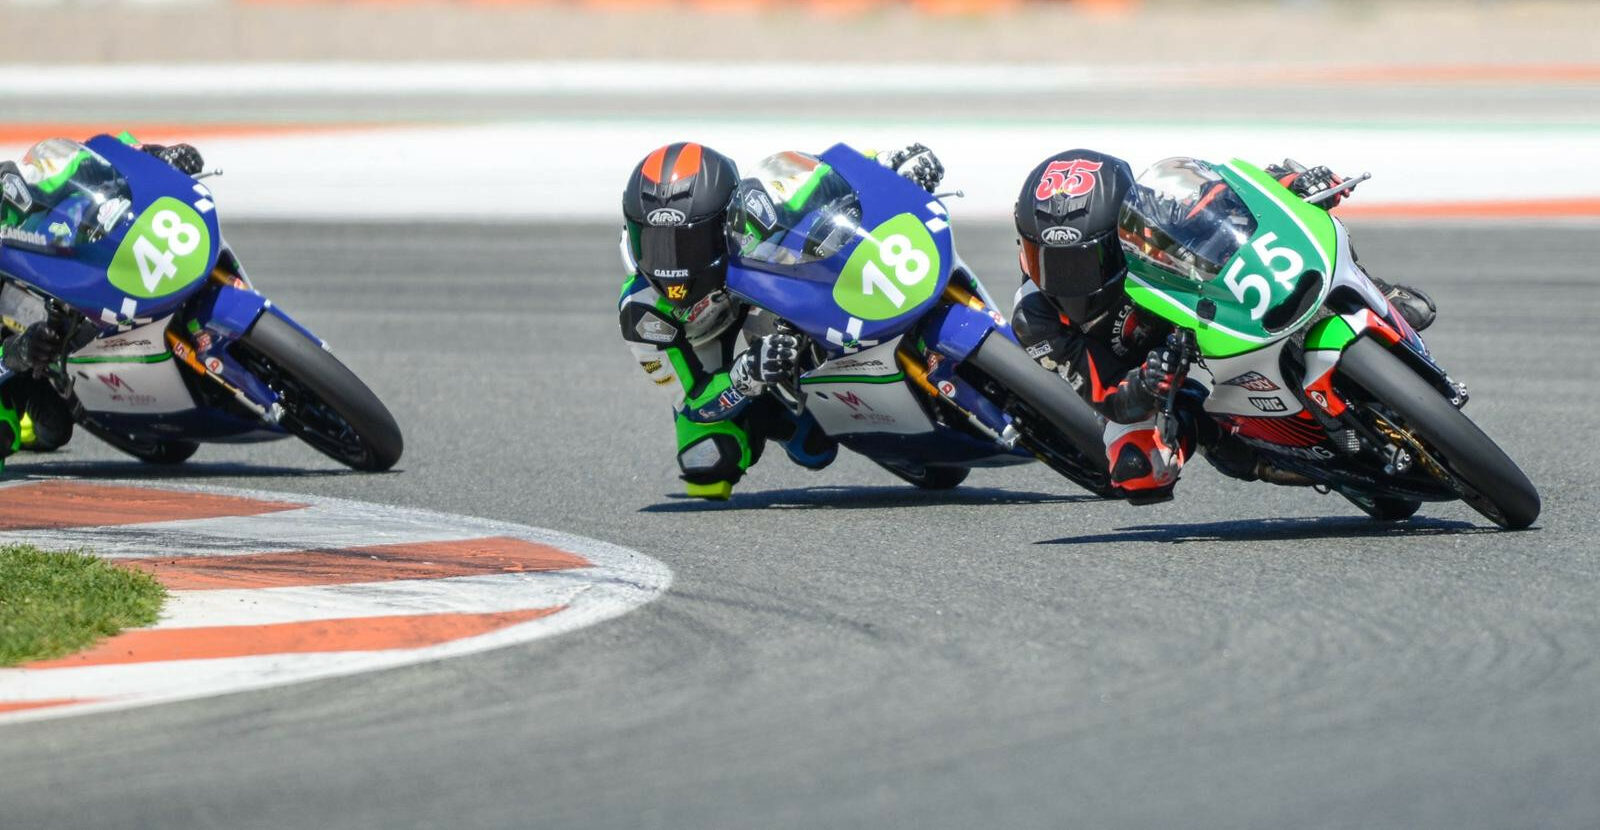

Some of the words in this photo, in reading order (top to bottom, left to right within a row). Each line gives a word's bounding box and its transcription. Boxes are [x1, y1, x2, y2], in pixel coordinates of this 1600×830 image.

[1035, 159, 1103, 201] 55
[132, 209, 201, 293] 48
[654, 269, 689, 278] GALFER
[861, 233, 931, 309] 18
[1223, 231, 1304, 321] 55
